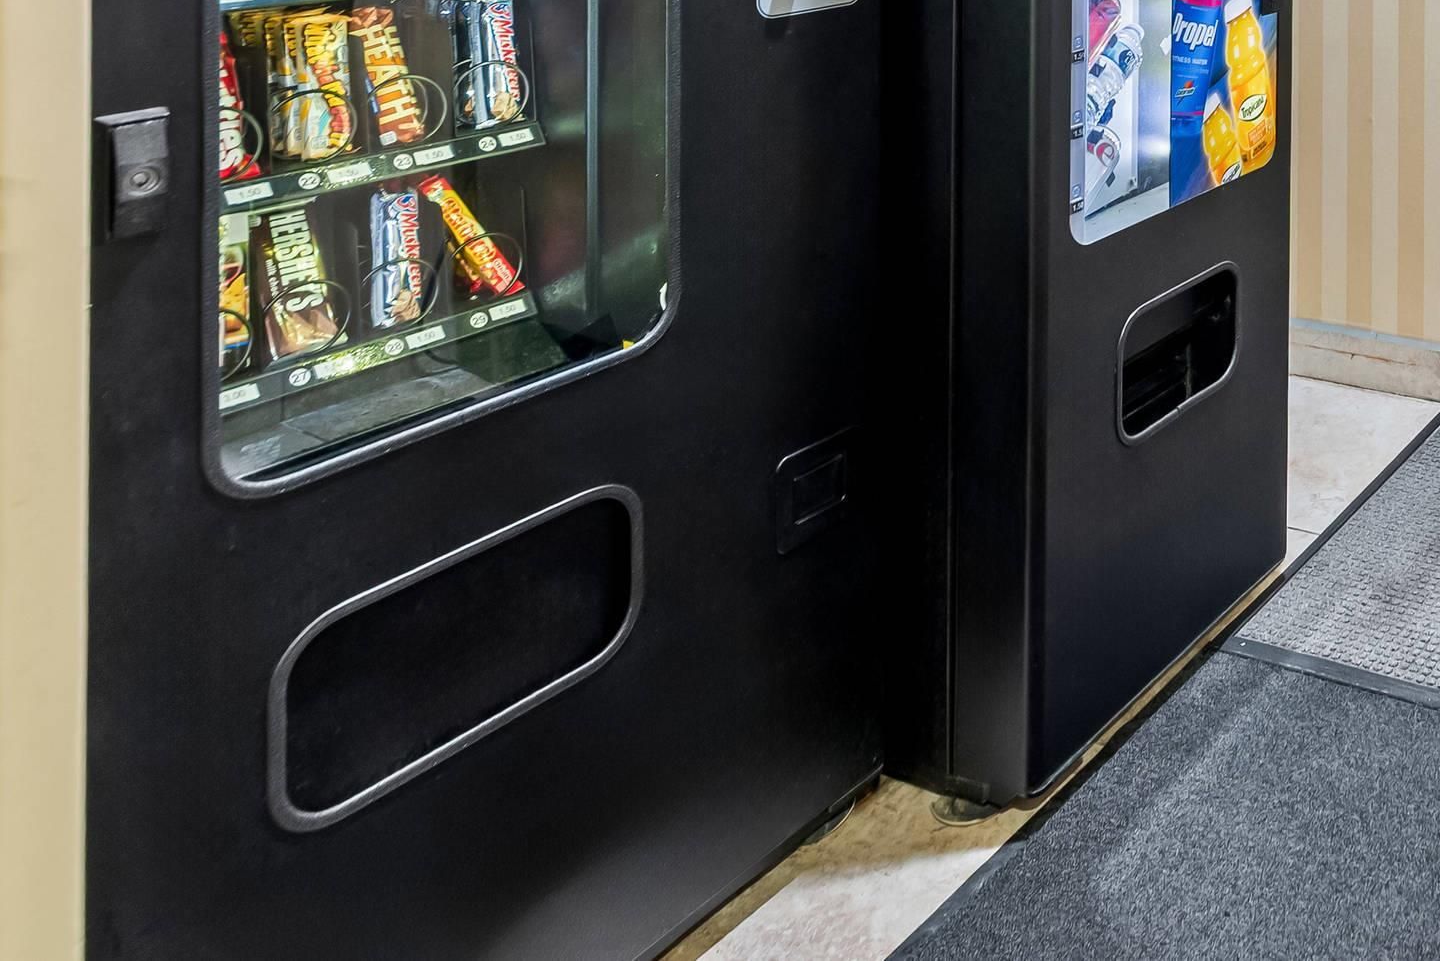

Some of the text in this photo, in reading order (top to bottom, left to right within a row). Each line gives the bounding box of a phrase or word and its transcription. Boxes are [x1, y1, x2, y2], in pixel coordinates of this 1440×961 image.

[1173, 13, 1218, 50] Propel
[362, 24, 415, 126] HEATH
[481, 139, 496, 149] 24
[396, 156, 411, 167] 23
[301, 176, 318, 187] 22
[471, 315, 487, 325] 29
[388, 341, 403, 352] 28
[292, 372, 308, 384] 27
